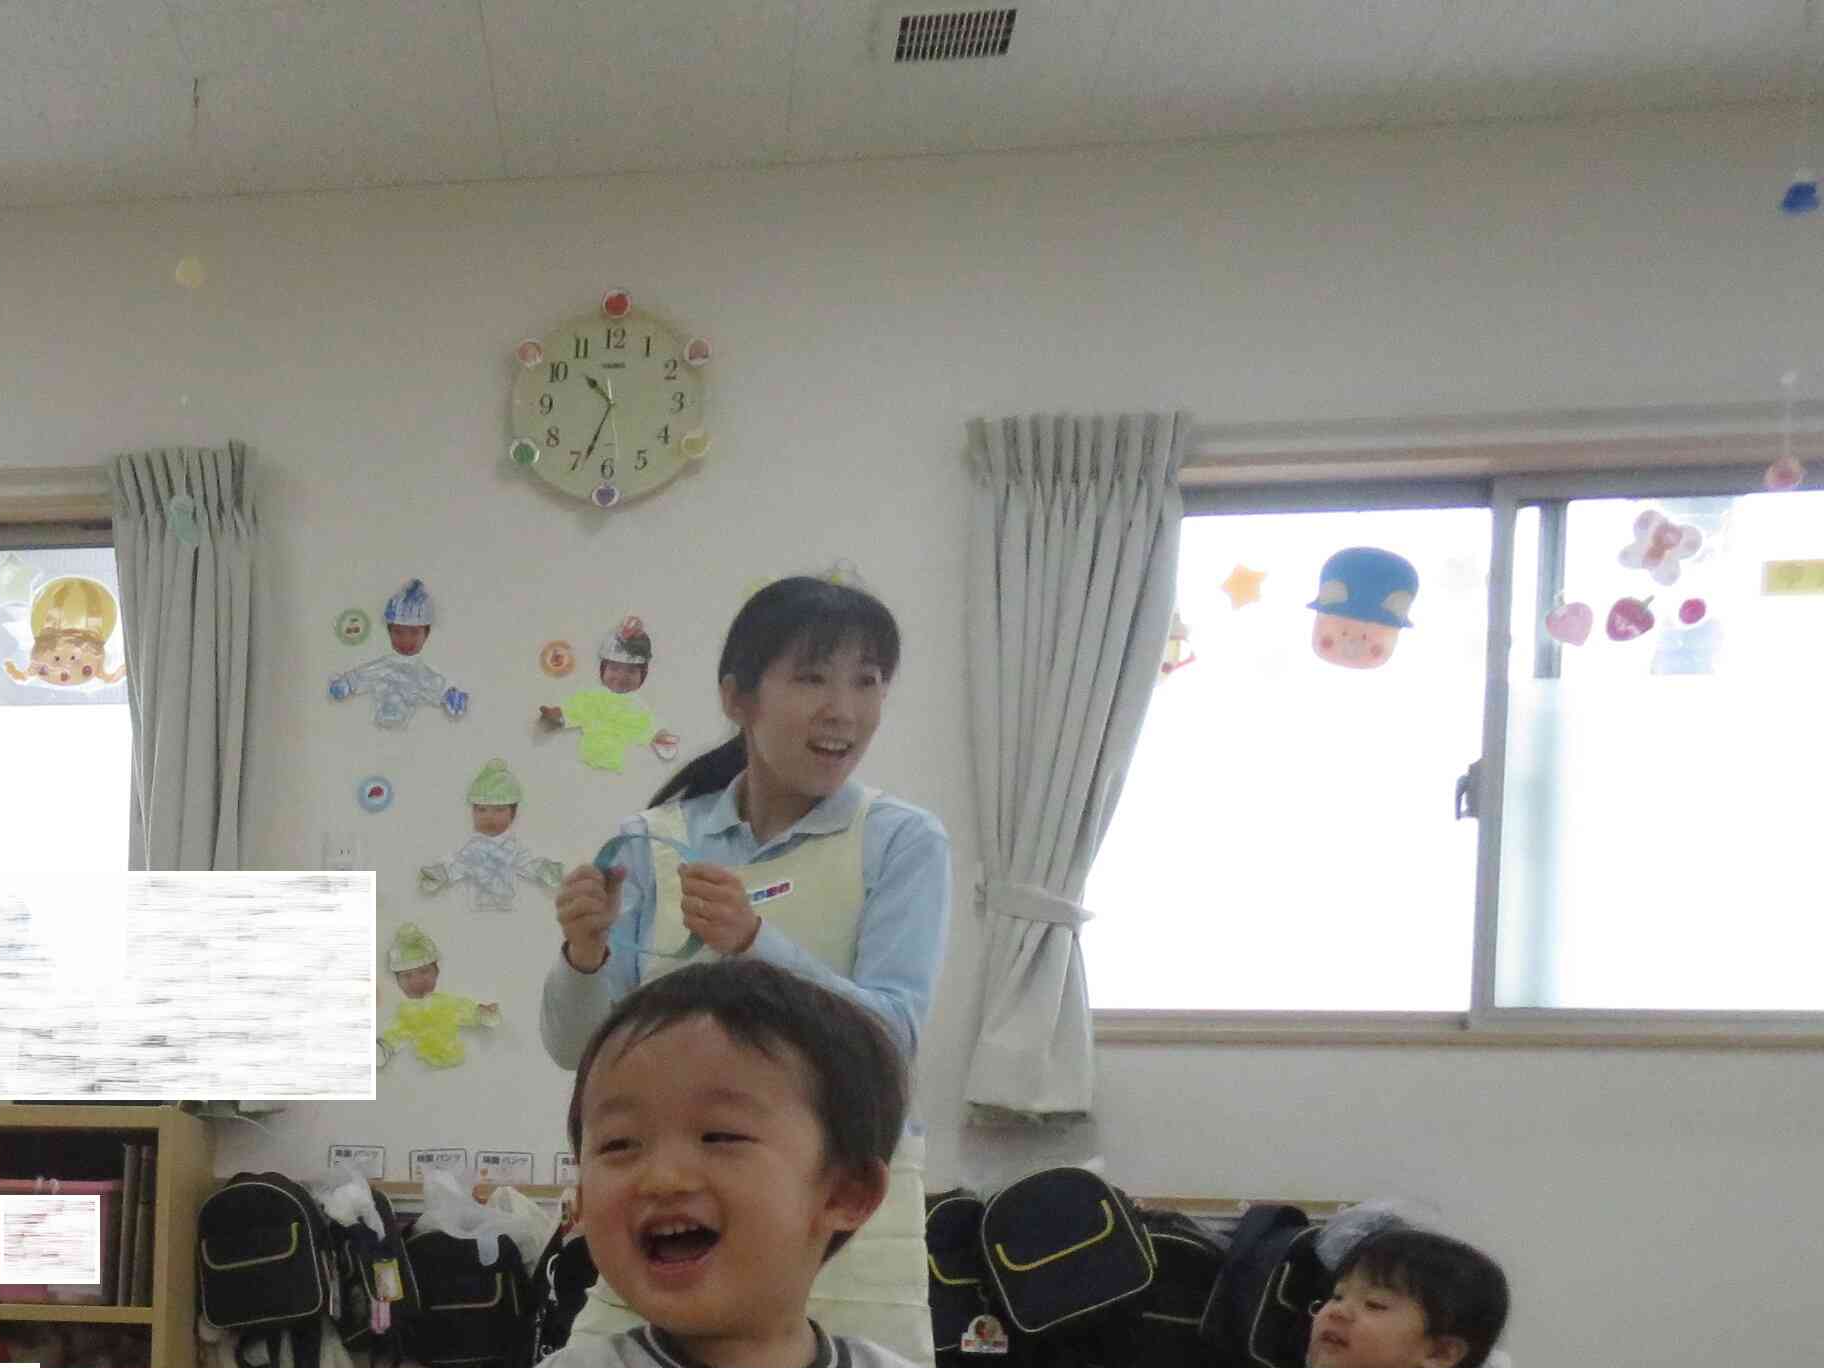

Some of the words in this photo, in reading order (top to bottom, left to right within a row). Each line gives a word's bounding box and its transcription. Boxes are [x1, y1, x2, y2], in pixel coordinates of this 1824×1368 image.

[573, 337, 589, 359] 11
[603, 328, 626, 350] 12
[643, 336, 651, 358] 1
[549, 362, 568, 383] 10
[664, 359, 678, 380] 2
[539, 394, 554, 415] 9
[670, 392, 685, 414] 3
[546, 426, 560, 447] 8
[657, 424, 671, 444] 4
[569, 451, 584, 471] 7
[600, 458, 614, 480] 6
[634, 450, 649, 470] 5
